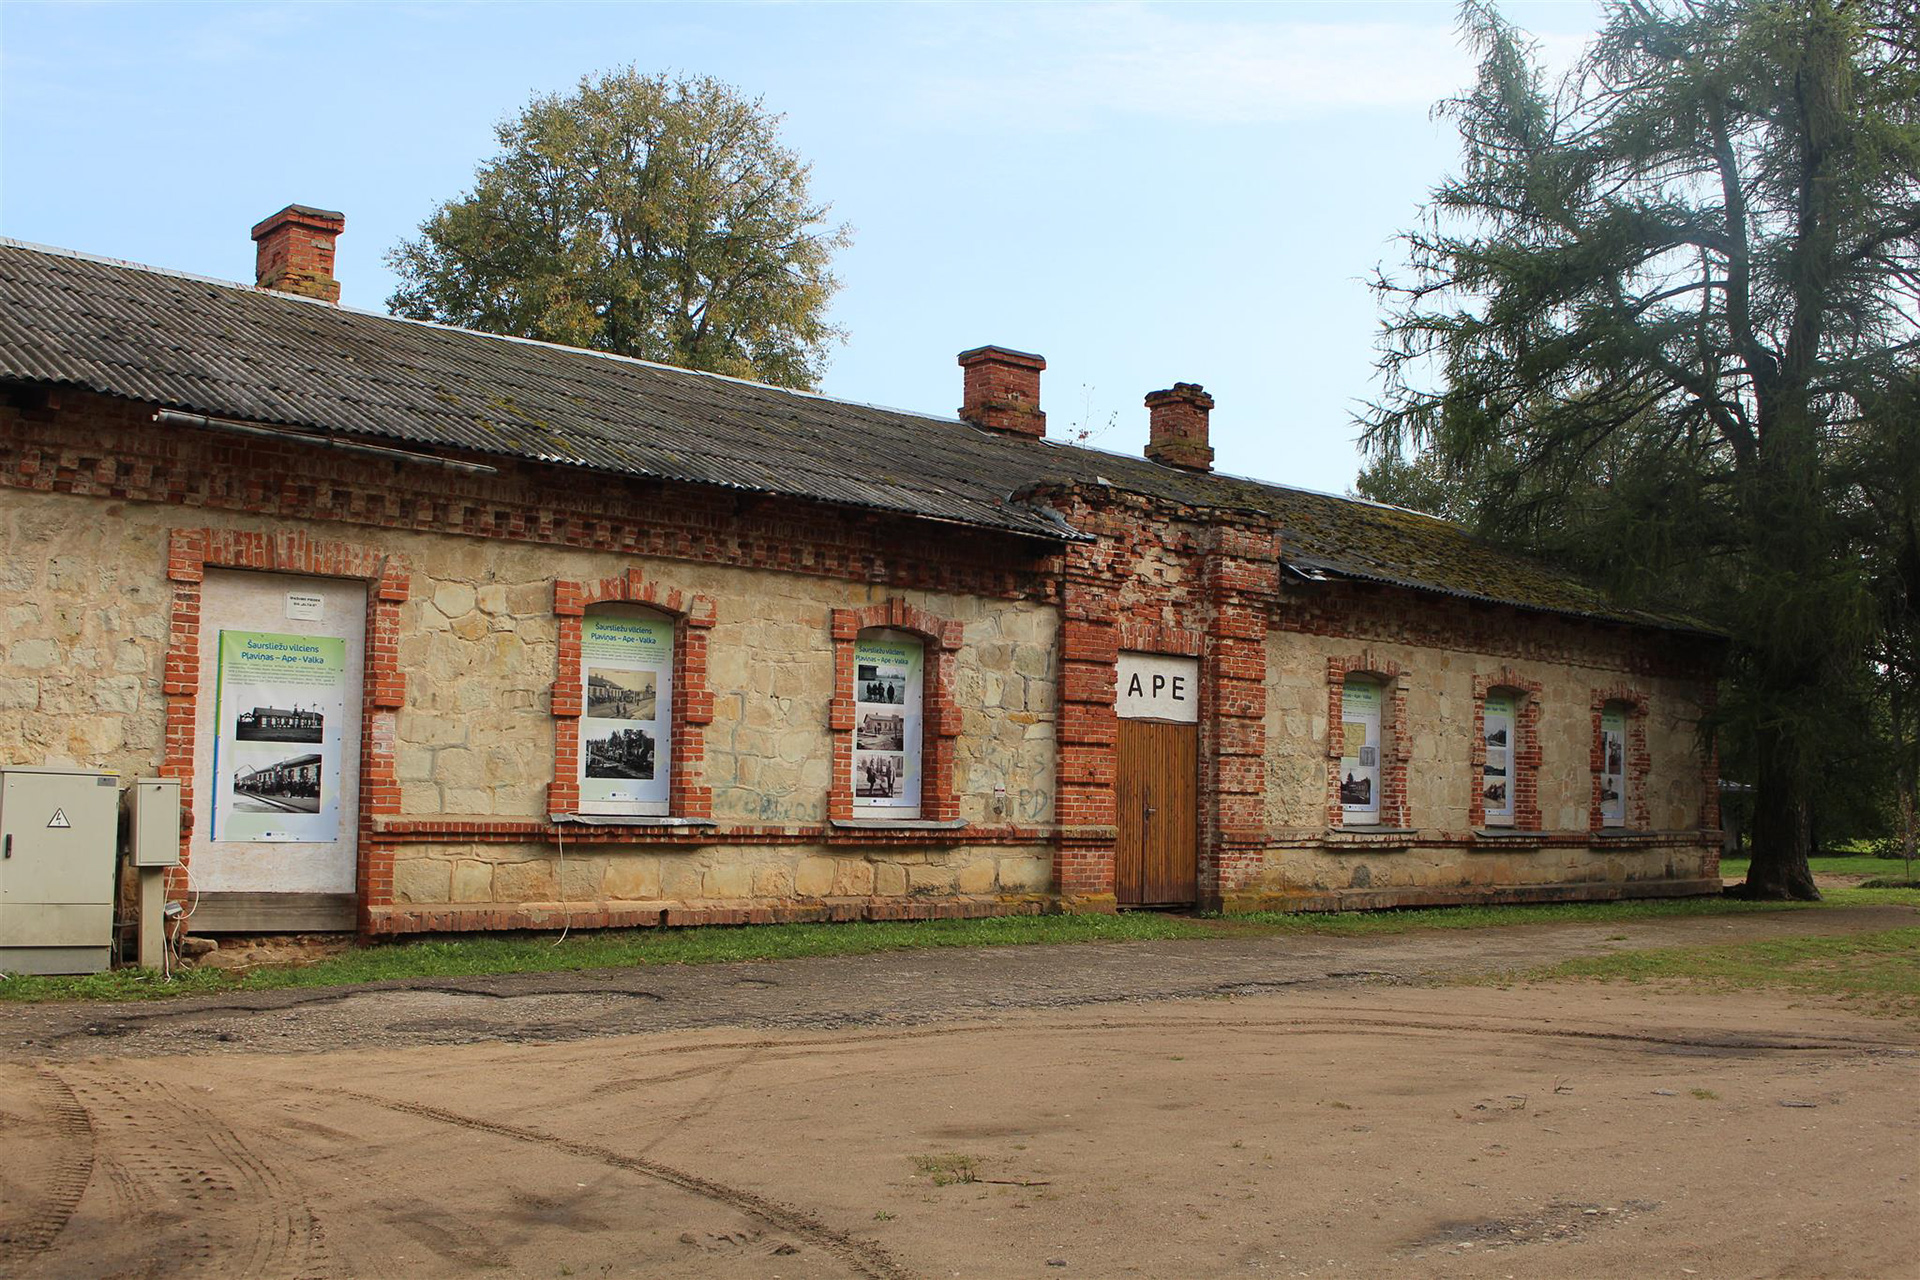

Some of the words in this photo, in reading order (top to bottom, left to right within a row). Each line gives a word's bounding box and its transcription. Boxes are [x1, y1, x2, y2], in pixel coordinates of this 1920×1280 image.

[247, 640, 288, 651] Šaursliežu
[289, 643, 319, 652] vilciens
[241, 652, 274, 662] Pļaviņas
[281, 655, 297, 663] Ape
[302, 655, 324, 664] Valka
[1127, 673, 1185, 701] APE
